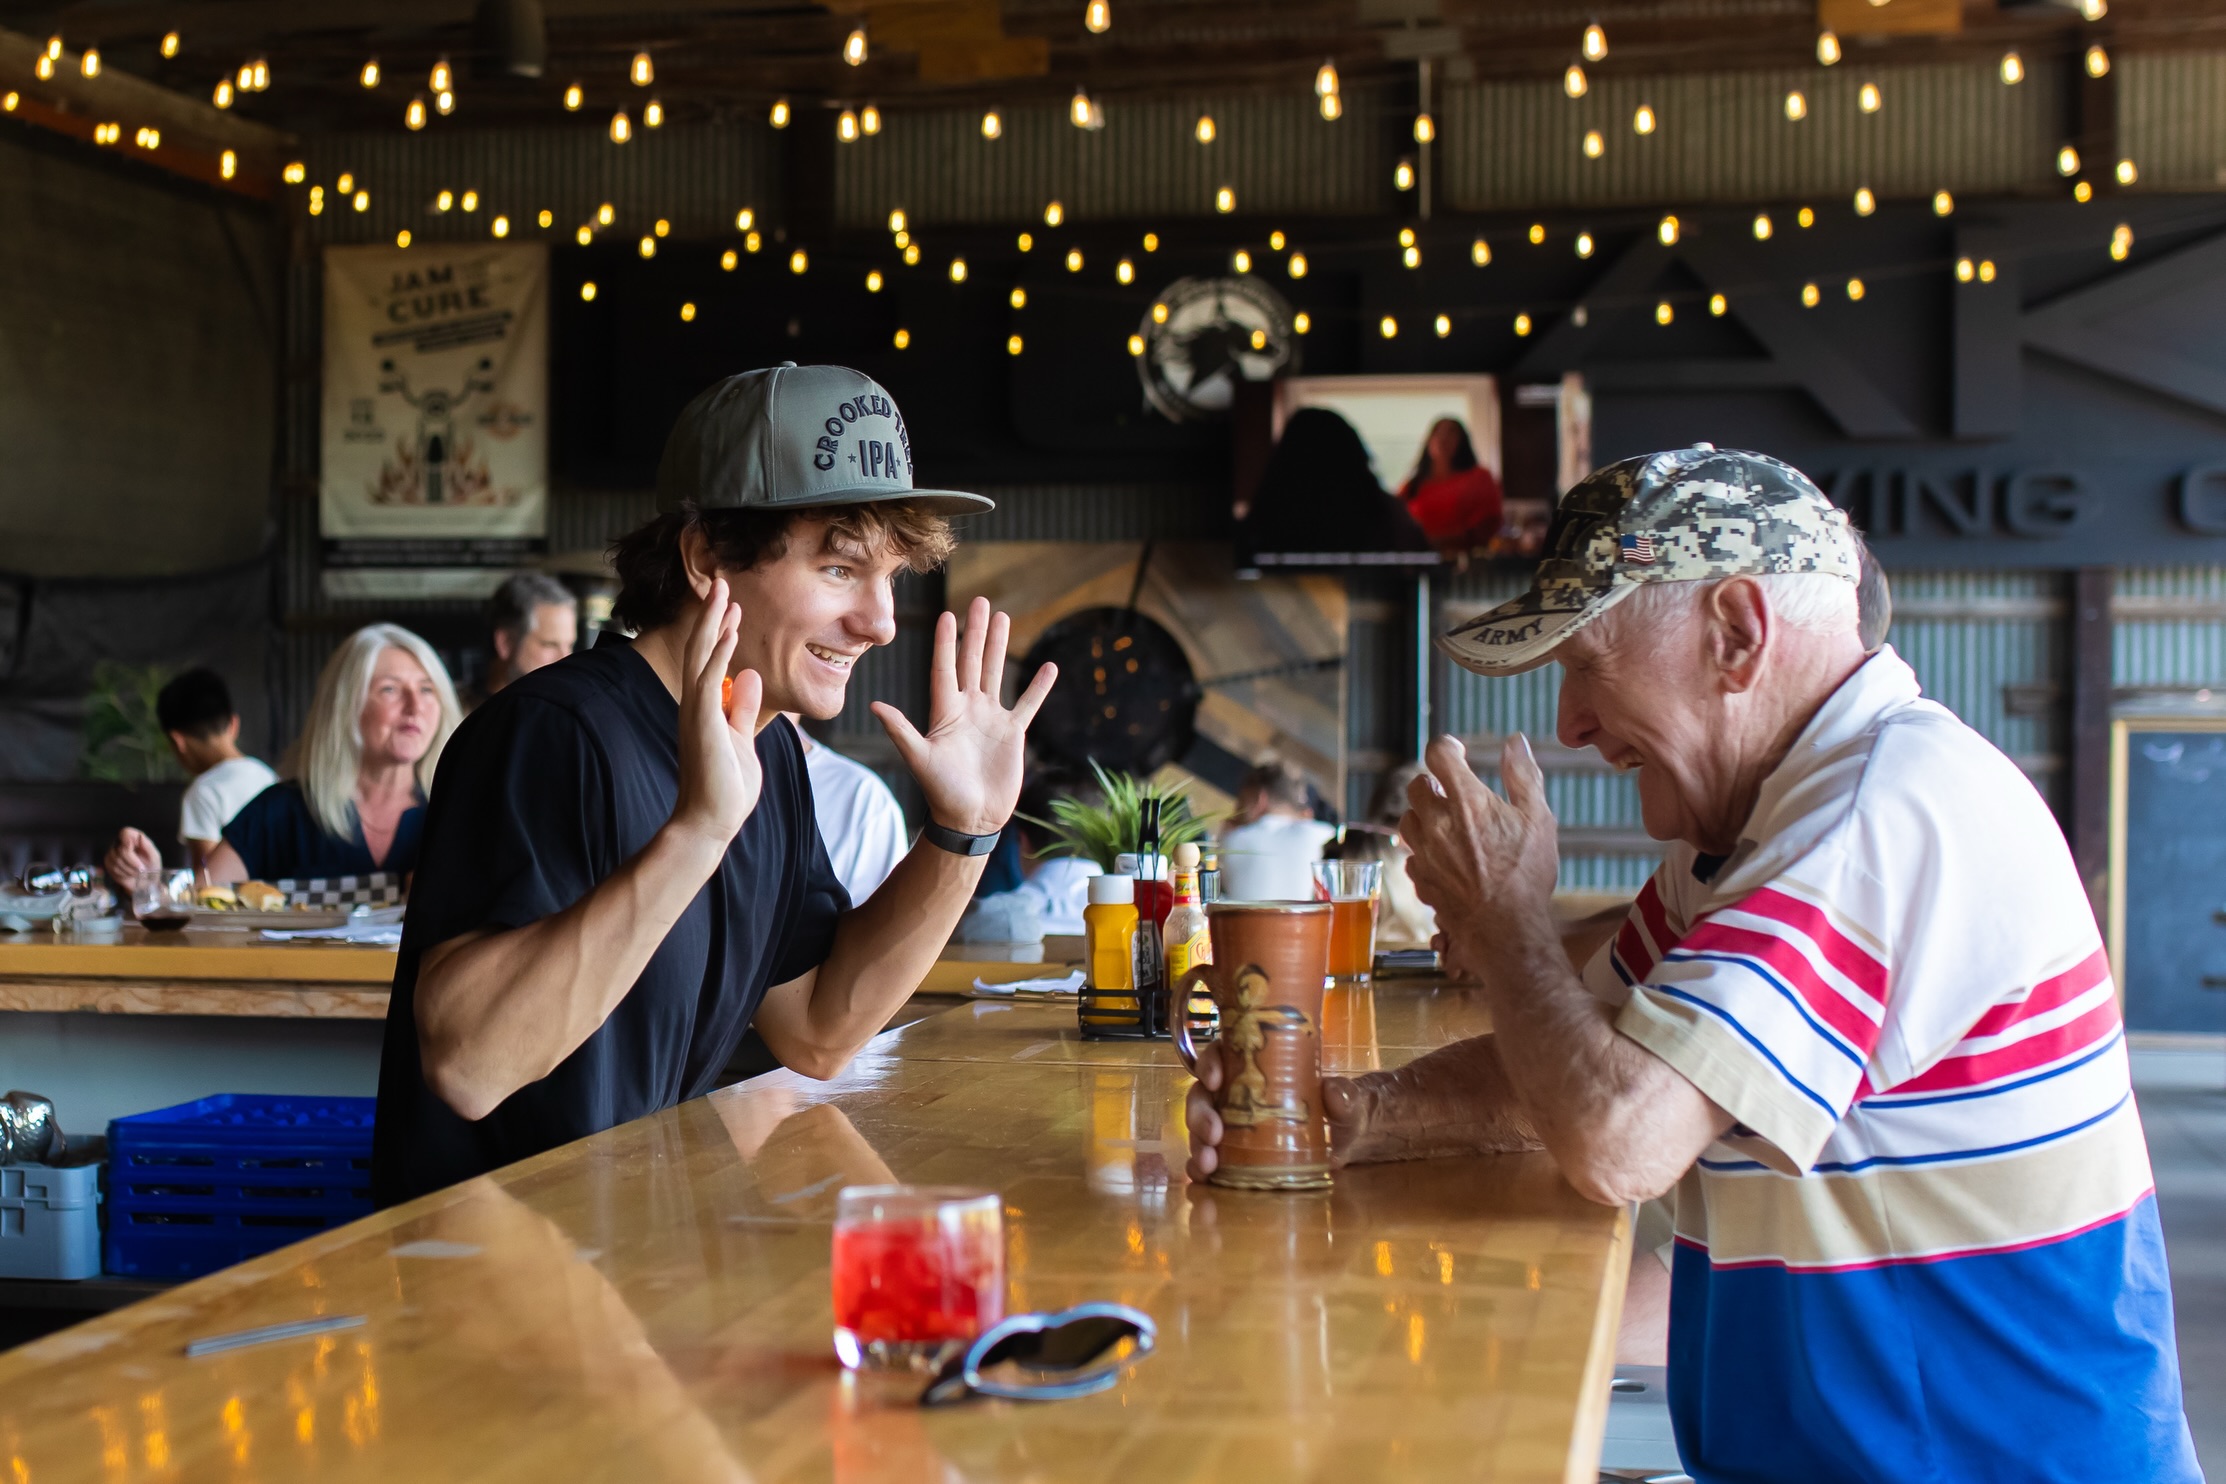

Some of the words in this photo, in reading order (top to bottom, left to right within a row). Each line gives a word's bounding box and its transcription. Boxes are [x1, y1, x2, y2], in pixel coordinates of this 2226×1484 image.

[387, 283, 490, 323] CURE
[813, 395, 892, 471] CROOKED
[858, 440, 898, 479] IPA
[1472, 616, 1544, 645] ARMY
